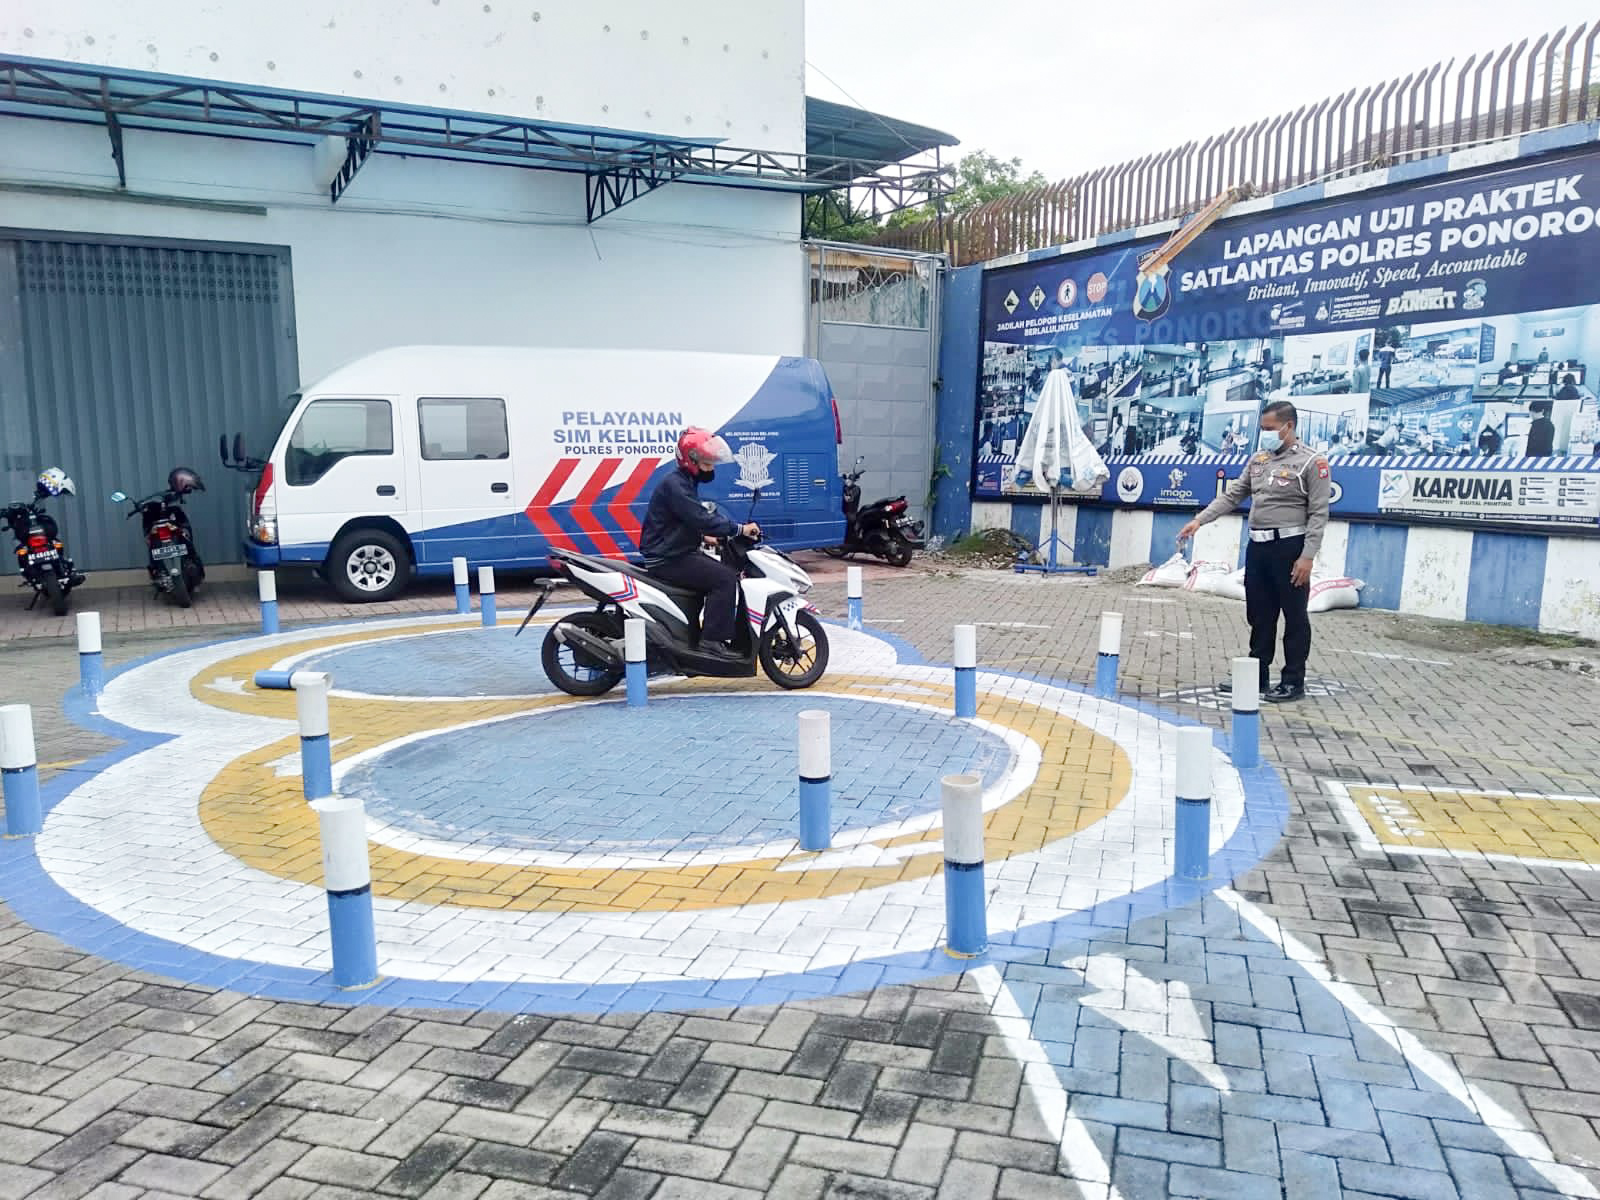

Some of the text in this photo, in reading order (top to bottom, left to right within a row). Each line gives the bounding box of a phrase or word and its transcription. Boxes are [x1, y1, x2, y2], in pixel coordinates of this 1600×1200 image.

[1224, 174, 1584, 260] LAPANGAN UJI PRAKTEK
[1180, 251, 1315, 292] SATLANTAS
[1320, 232, 1432, 270] POLRES
[1439, 206, 1600, 252] PONORO
[1247, 248, 1528, 302] Briliant, Innovatif, Speed, Accountable
[1088, 280, 1107, 295] STOP
[1385, 291, 1457, 316] BANGKIT
[997, 307, 1113, 332] JADILAH PELOPOR KESELAMATAN
[1024, 322, 1080, 337] BERLALULINTAS
[562, 411, 683, 426] PELAYANAN
[553, 429, 686, 443] SIM KELILIN
[565, 445, 676, 455] POLRES PONOROG
[1160, 488, 1193, 499] imago
[1412, 477, 1513, 501] KARUNIA
